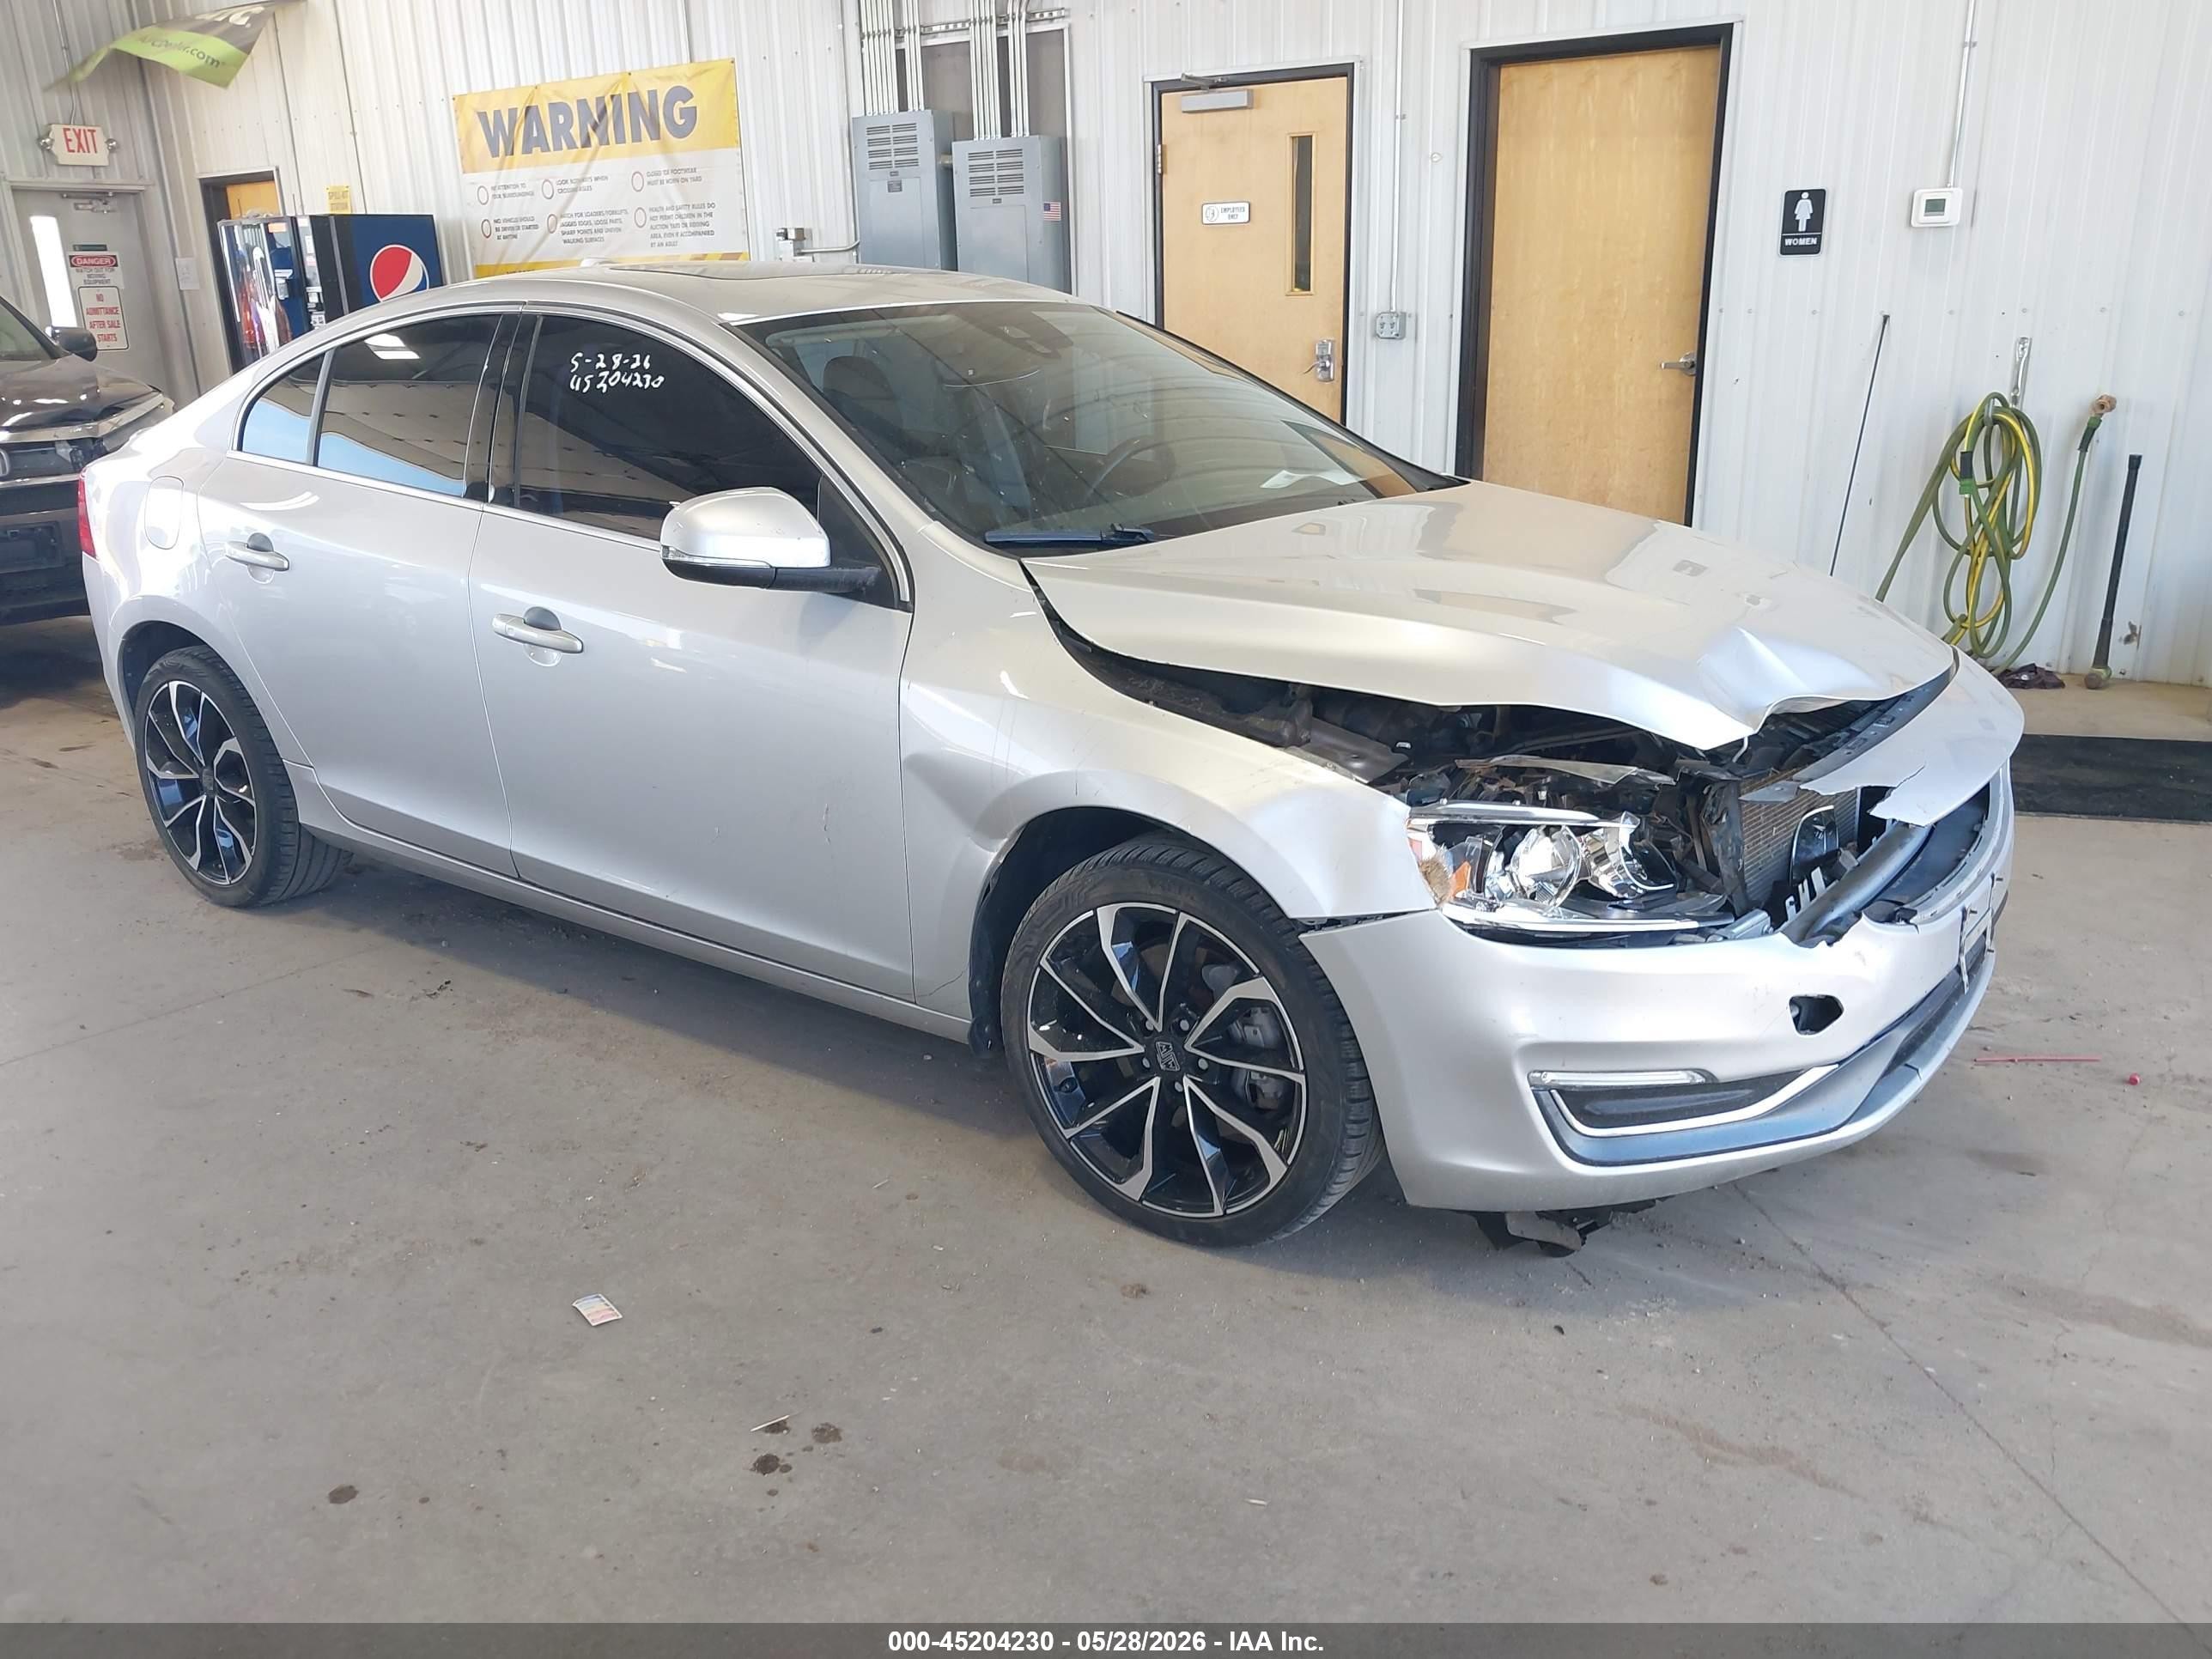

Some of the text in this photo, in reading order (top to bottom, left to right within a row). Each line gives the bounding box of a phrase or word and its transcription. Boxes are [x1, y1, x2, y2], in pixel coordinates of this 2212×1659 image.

[477, 85, 698, 159] WARNING
[63, 127, 98, 154] EXIT
[1784, 237, 1818, 246] WOMEN
[95, 293, 104, 302] NO
[86, 307, 119, 315] ADMITTANCE
[89, 319, 121, 329] AFTER SALE
[97, 333, 118, 342] STARTS
